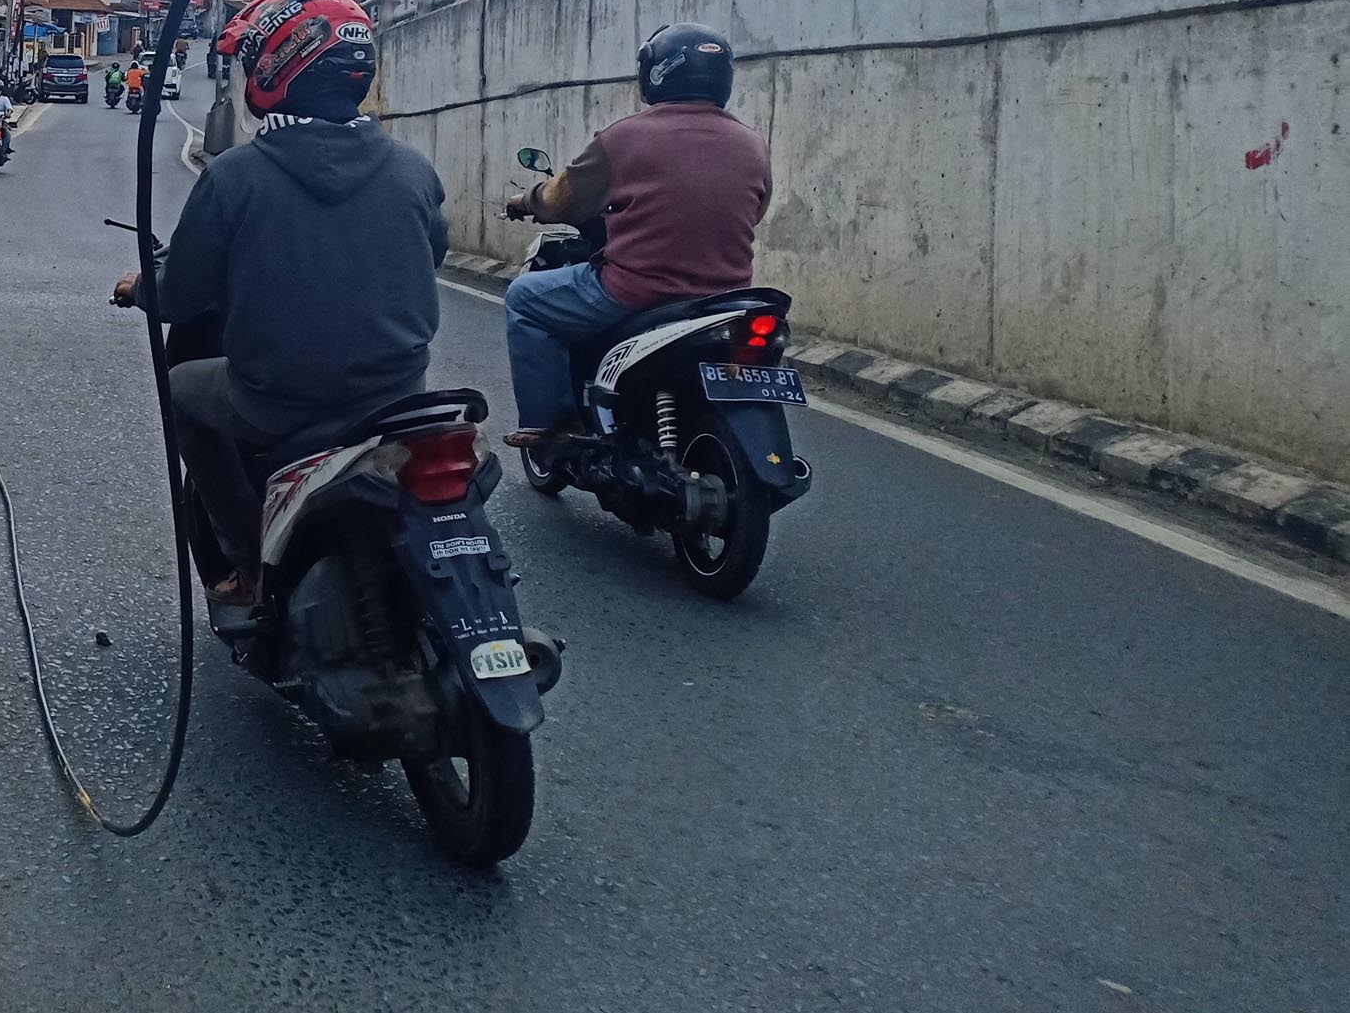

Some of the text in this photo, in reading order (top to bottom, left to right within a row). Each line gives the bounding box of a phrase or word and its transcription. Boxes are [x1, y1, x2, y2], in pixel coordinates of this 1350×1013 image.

[341, 27, 370, 40] NHK
[706, 366, 795, 387] BE 4659 BT
[433, 512, 467, 523] HONDA
